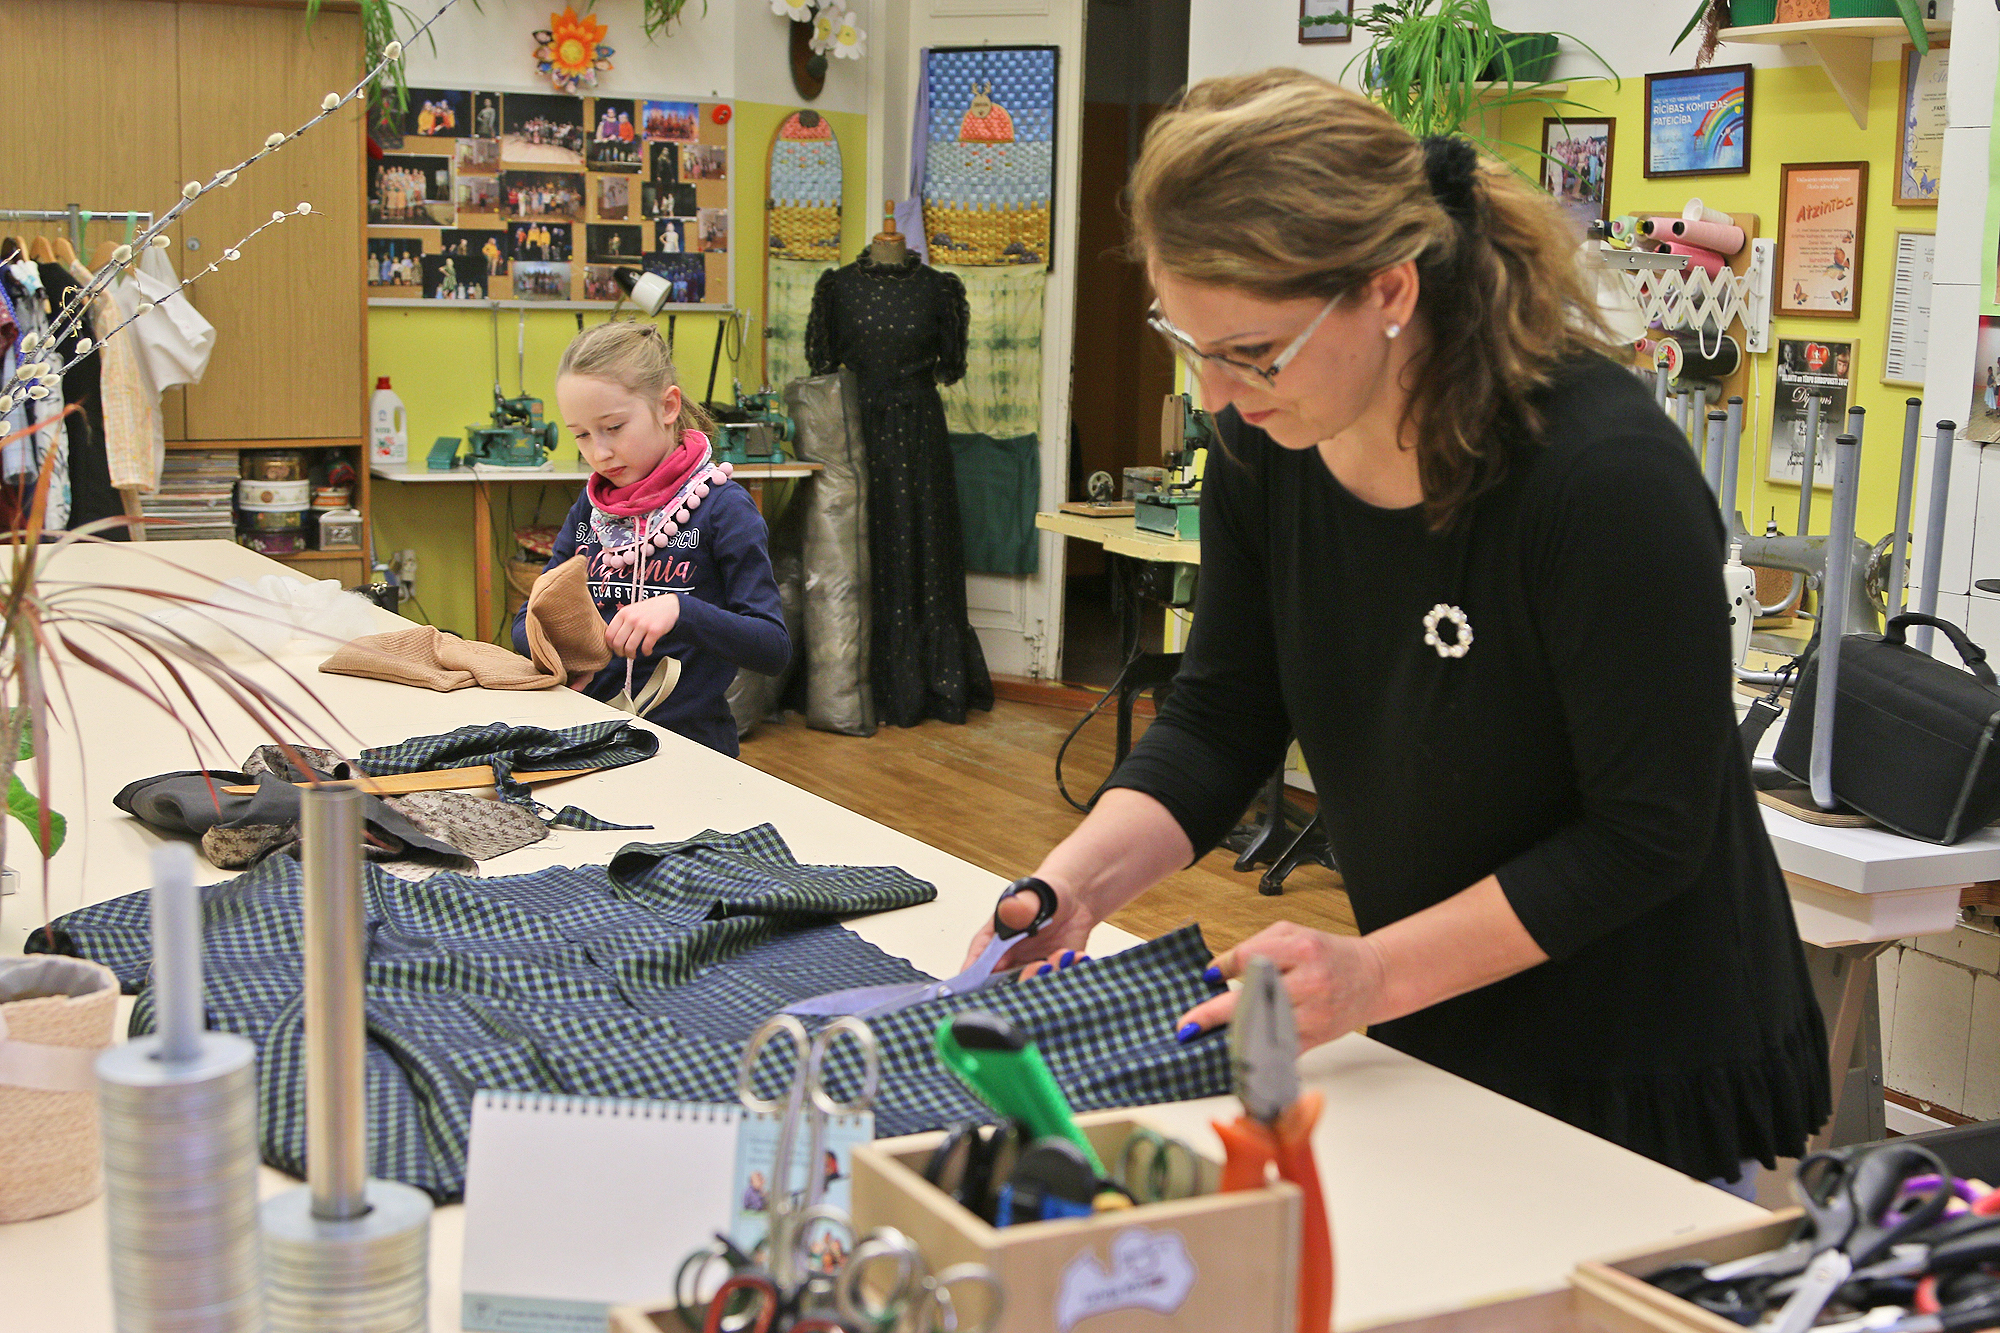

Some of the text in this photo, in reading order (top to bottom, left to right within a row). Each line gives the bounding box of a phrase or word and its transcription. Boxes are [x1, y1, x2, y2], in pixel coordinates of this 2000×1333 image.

[1653, 99, 1729, 114] RĪCĪBAS KOMITEJAS
[1653, 114, 1692, 126] PATEICĪBA
